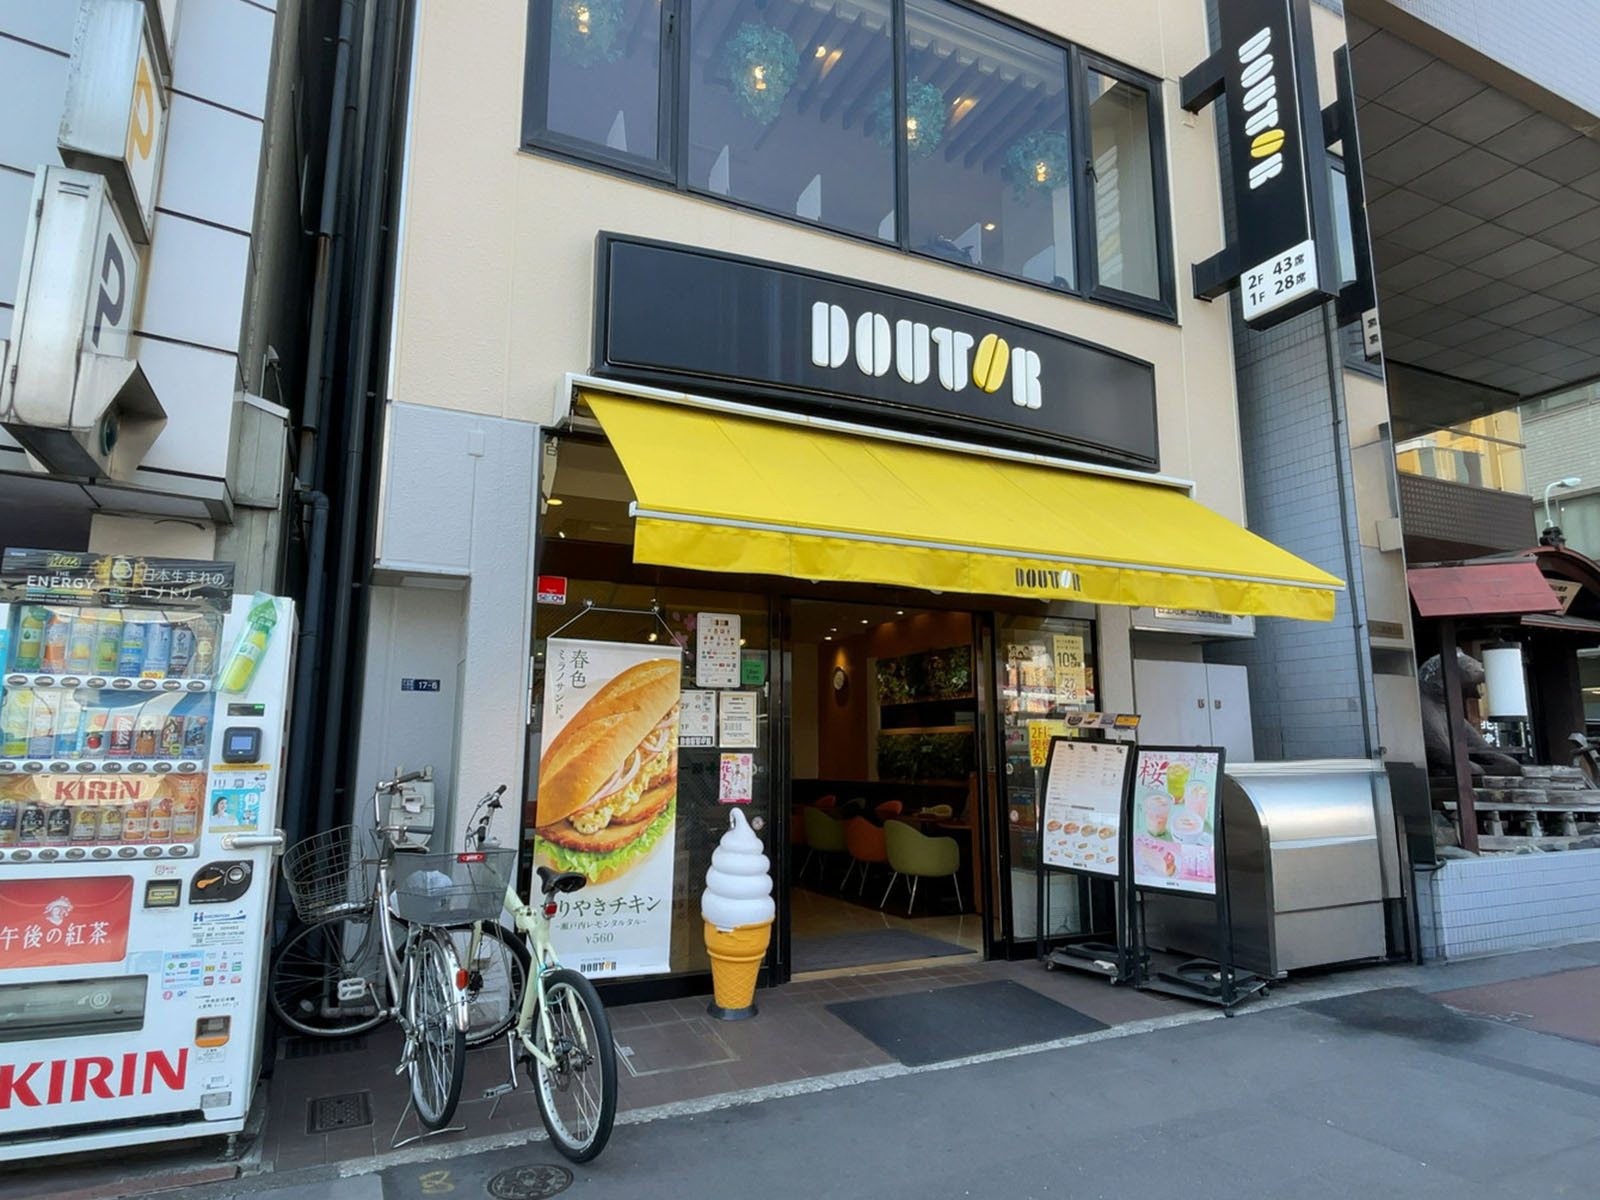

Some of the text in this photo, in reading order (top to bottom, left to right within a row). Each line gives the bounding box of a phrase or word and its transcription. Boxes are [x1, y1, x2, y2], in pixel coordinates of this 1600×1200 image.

[1238, 26, 1285, 190] DOUTOR
[1248, 273, 1264, 290] 2F
[1249, 291, 1265, 306] 1F
[811, 301, 1042, 410] DOUTOR
[27, 575, 95, 589] ENERGY
[143, 568, 225, 586] 日本生まれの
[1015, 567, 1081, 592] DOUTOR
[570, 649, 590, 689] 春色
[1139, 760, 1167, 786] 桜
[55, 781, 141, 800] KIRIN
[0, 921, 110, 951] 午後の紅茶
[0, 1048, 189, 1109] KIRIN
